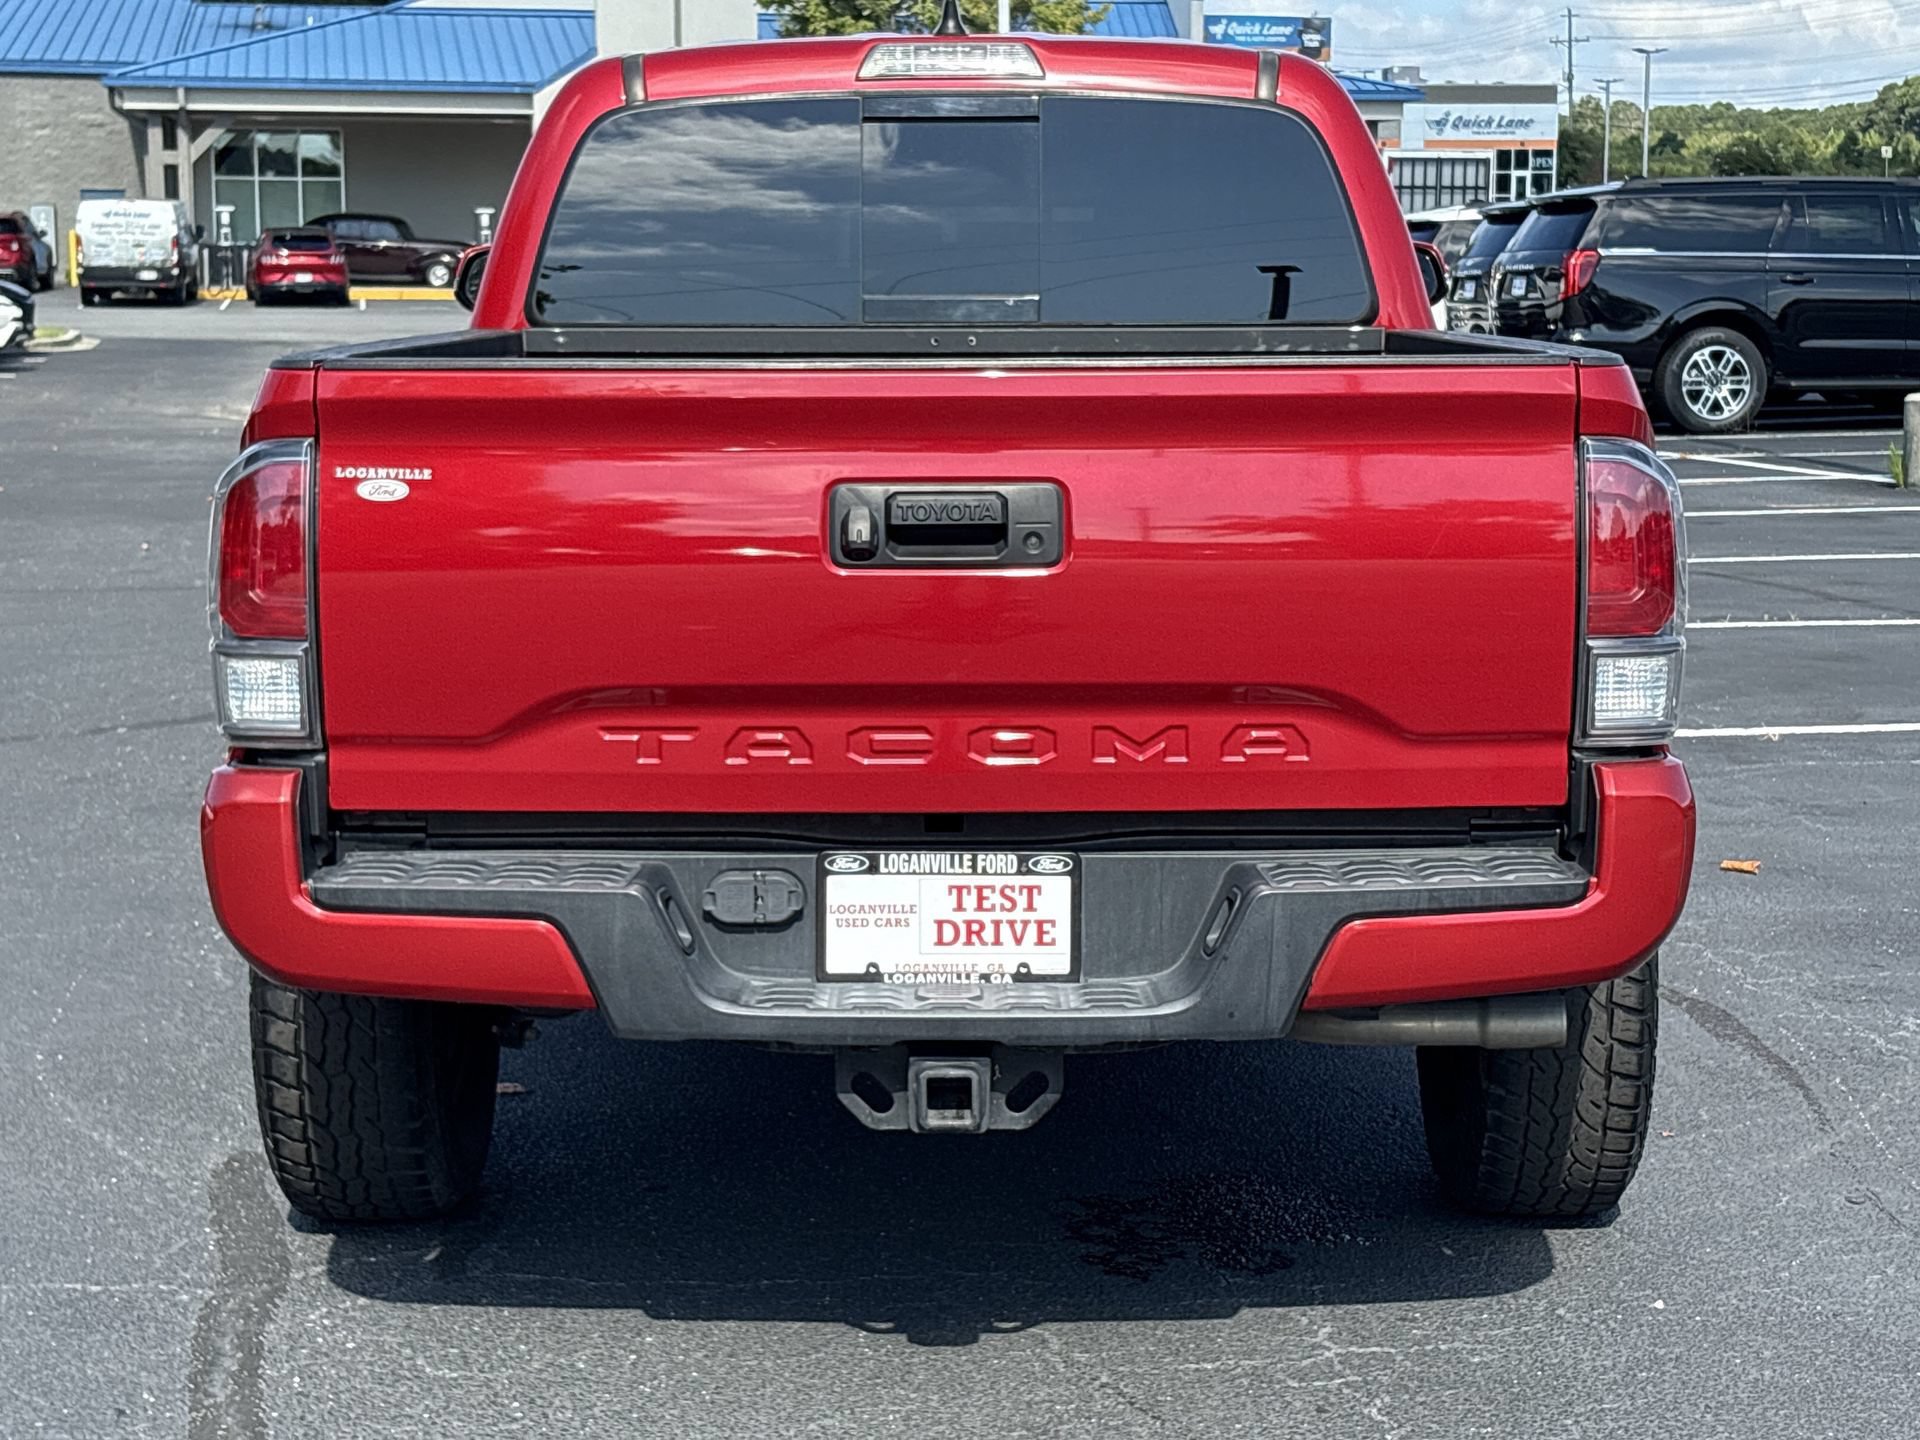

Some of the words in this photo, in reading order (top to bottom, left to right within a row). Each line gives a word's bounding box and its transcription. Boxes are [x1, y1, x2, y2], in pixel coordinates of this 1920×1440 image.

[1226, 21, 1261, 37] Quick
[1262, 22, 1294, 36] Lane
[1450, 115, 1495, 131] Quick
[1494, 115, 1535, 130] Lane
[335, 467, 433, 480] LOGANVILLE
[368, 484, 398, 497] Ford
[896, 502, 998, 522] TOYOTA
[598, 724, 1311, 764] TACOMA
[833, 857, 861, 870] Ford
[879, 853, 973, 874] LOGANVILLE
[976, 854, 1018, 874] FORD
[1037, 858, 1065, 871] Ford
[947, 884, 1042, 913] TEST
[829, 904, 918, 915] LOGANVILLE
[835, 918, 870, 928] USED
[873, 917, 911, 928] CARS
[933, 919, 1056, 947] DRIVE
[895, 963, 979, 974] LOGANVILLE
[987, 963, 1005, 974] GA
[990, 972, 1014, 985] GA
